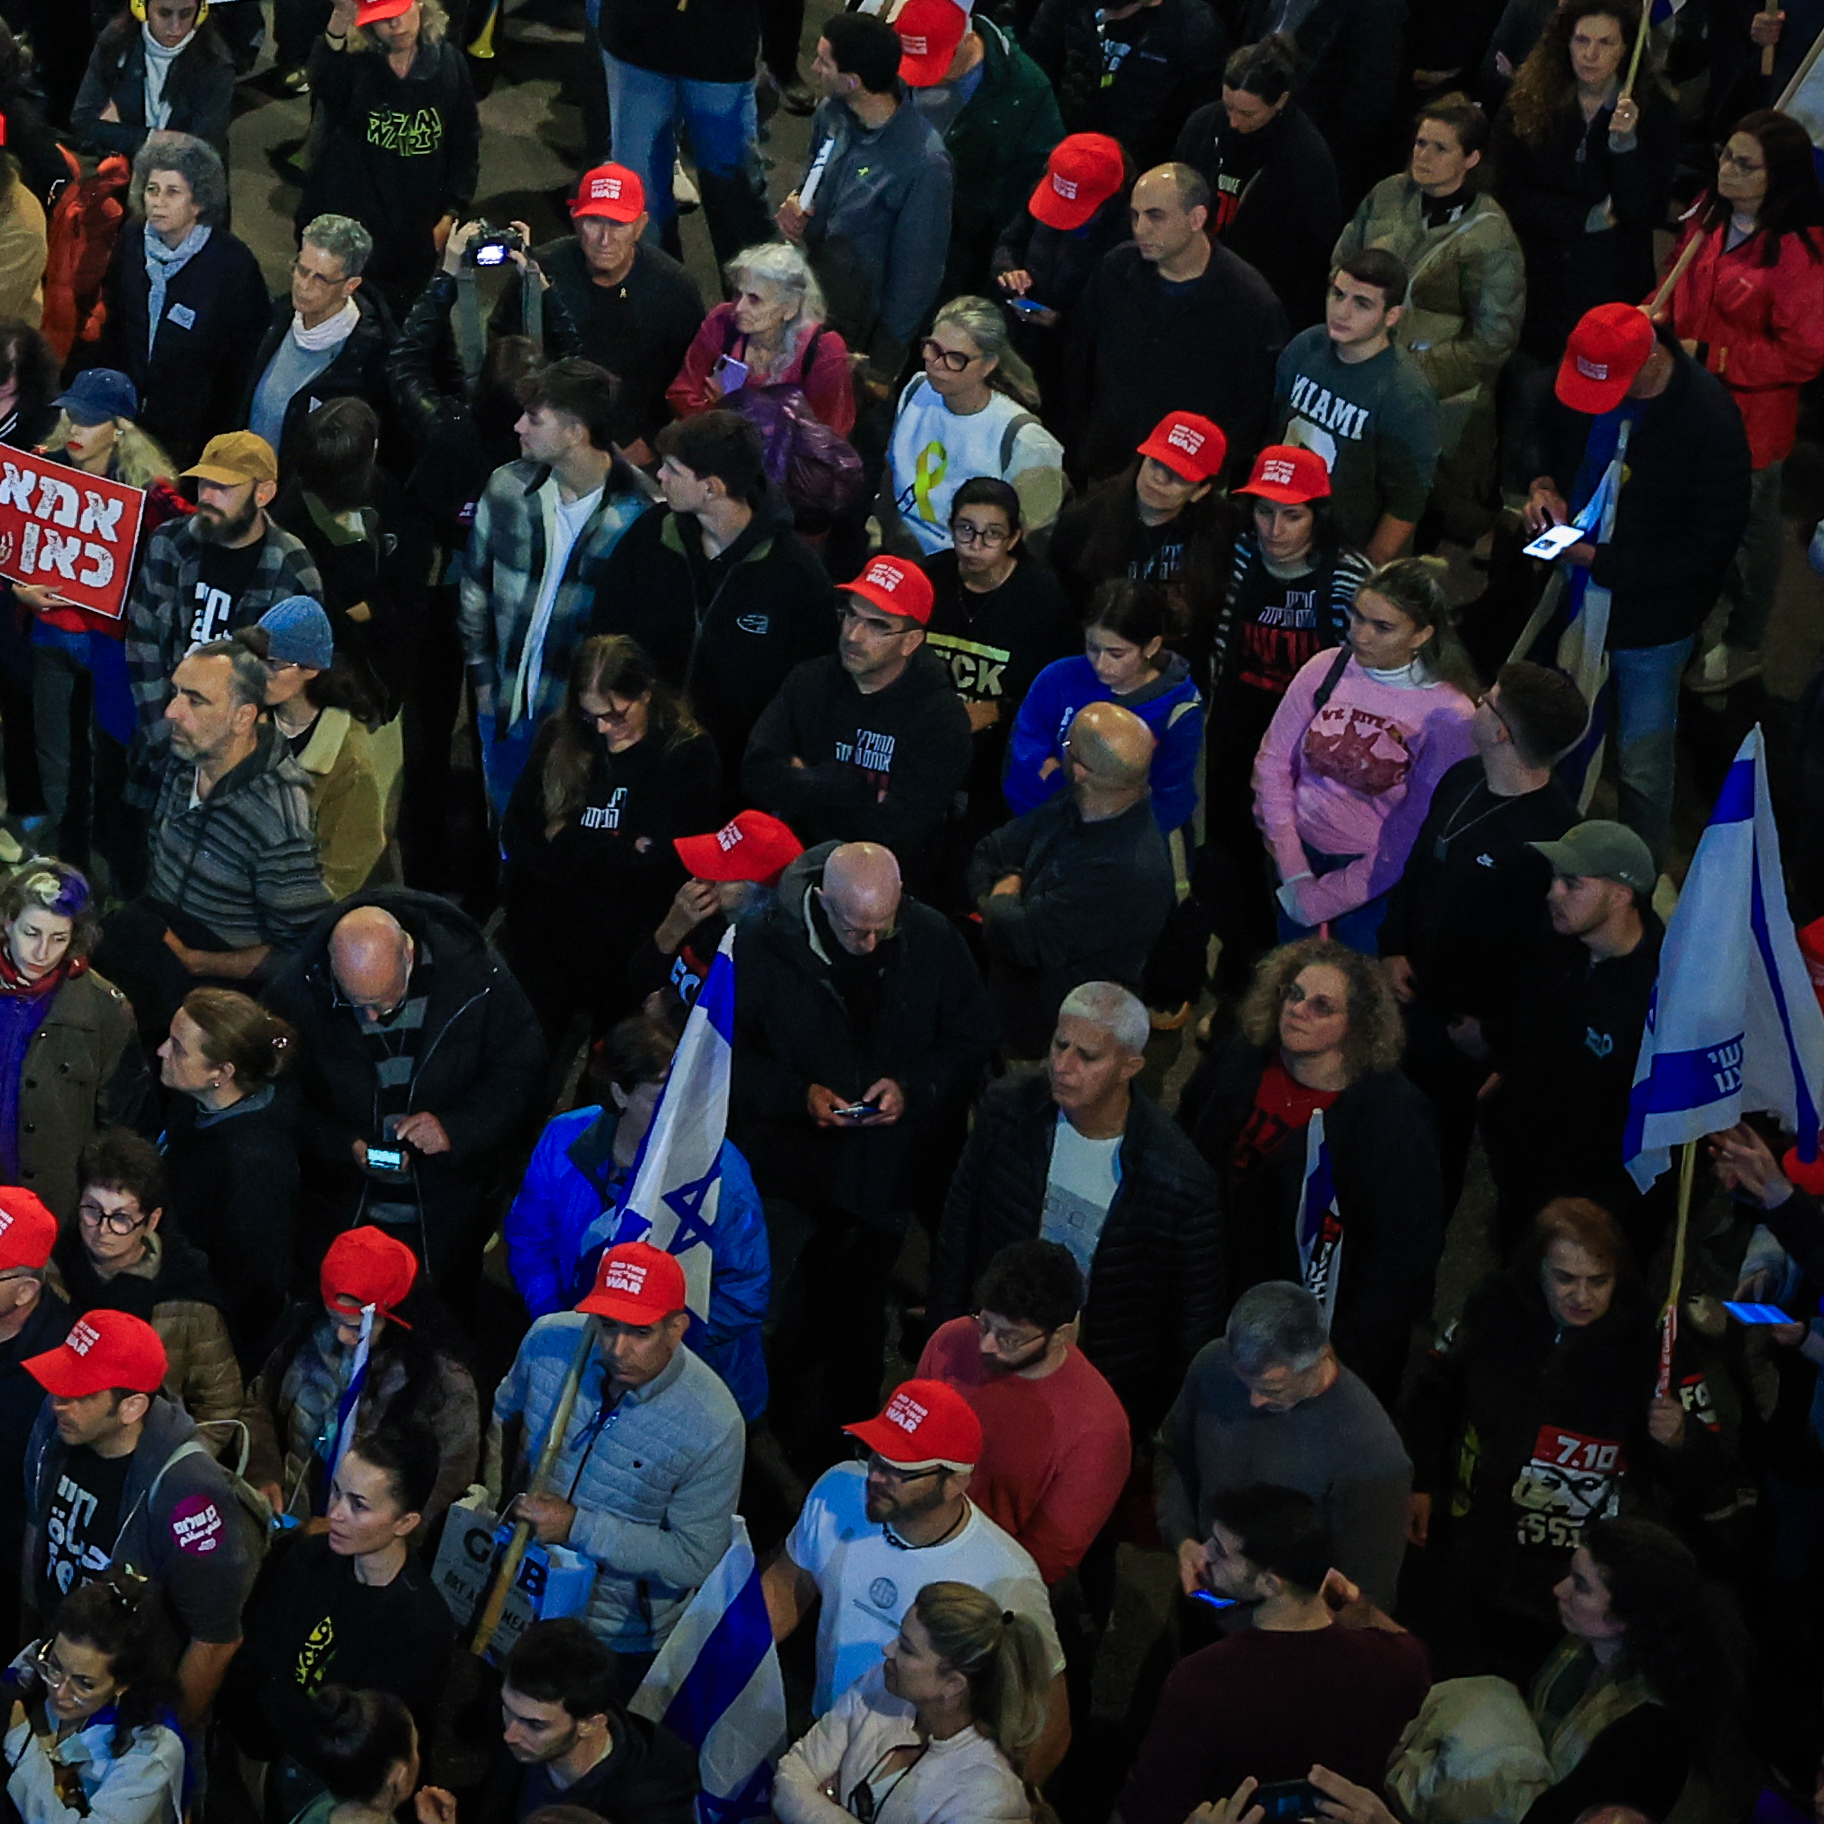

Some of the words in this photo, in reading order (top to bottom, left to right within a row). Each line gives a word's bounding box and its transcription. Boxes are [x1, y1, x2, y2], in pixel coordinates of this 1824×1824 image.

[1290, 373, 1372, 441] MIAMI
[19, 520, 117, 589] כאן
[1558, 1435, 1621, 1473] 7.10
